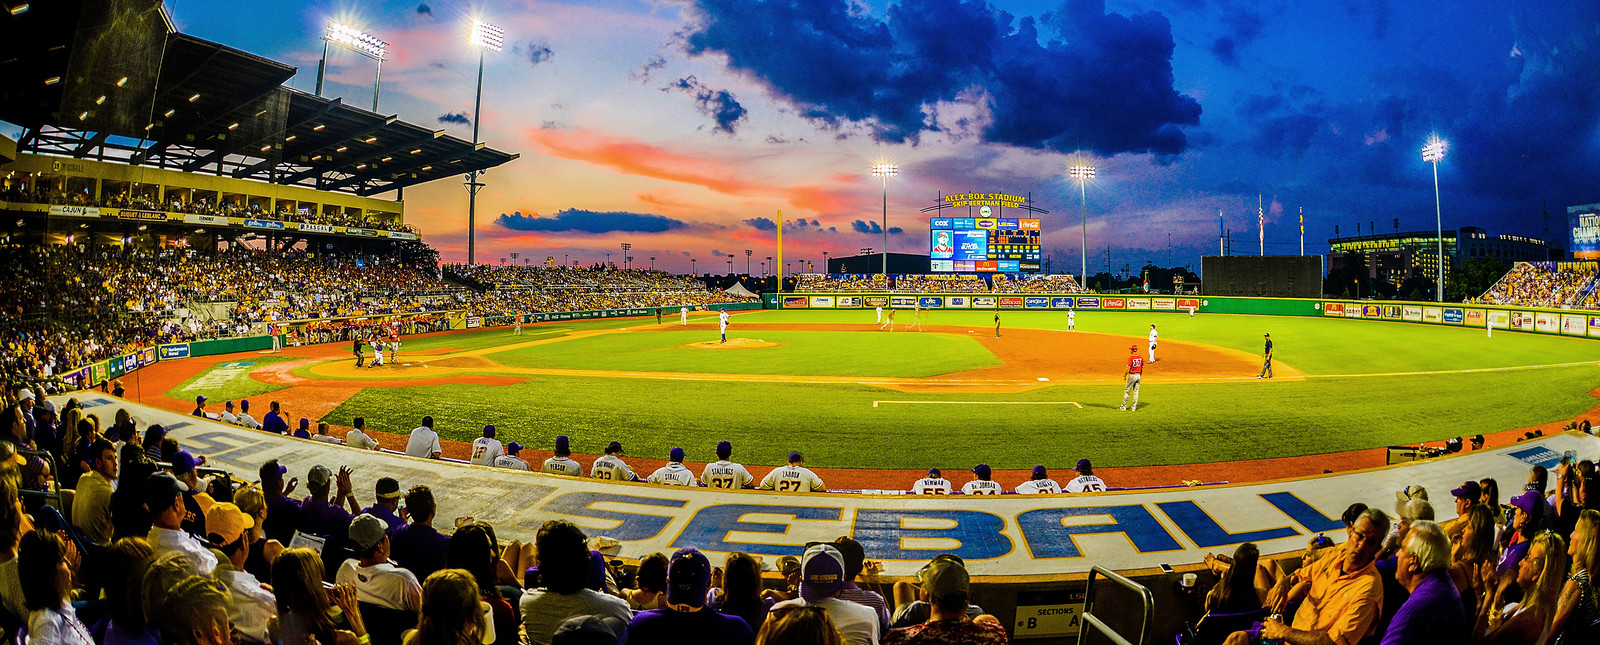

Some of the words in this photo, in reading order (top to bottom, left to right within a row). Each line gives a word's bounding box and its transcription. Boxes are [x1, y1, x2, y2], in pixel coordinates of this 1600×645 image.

[945, 194, 965, 202] ALEX
[988, 193, 1025, 203] STADIUM
[1579, 215, 1600, 228] NATIO
[780, 480, 801, 492] 27
[1037, 608, 1074, 616] SECTIONS
[1027, 616, 1037, 629] B
[1069, 614, 1079, 627] A
